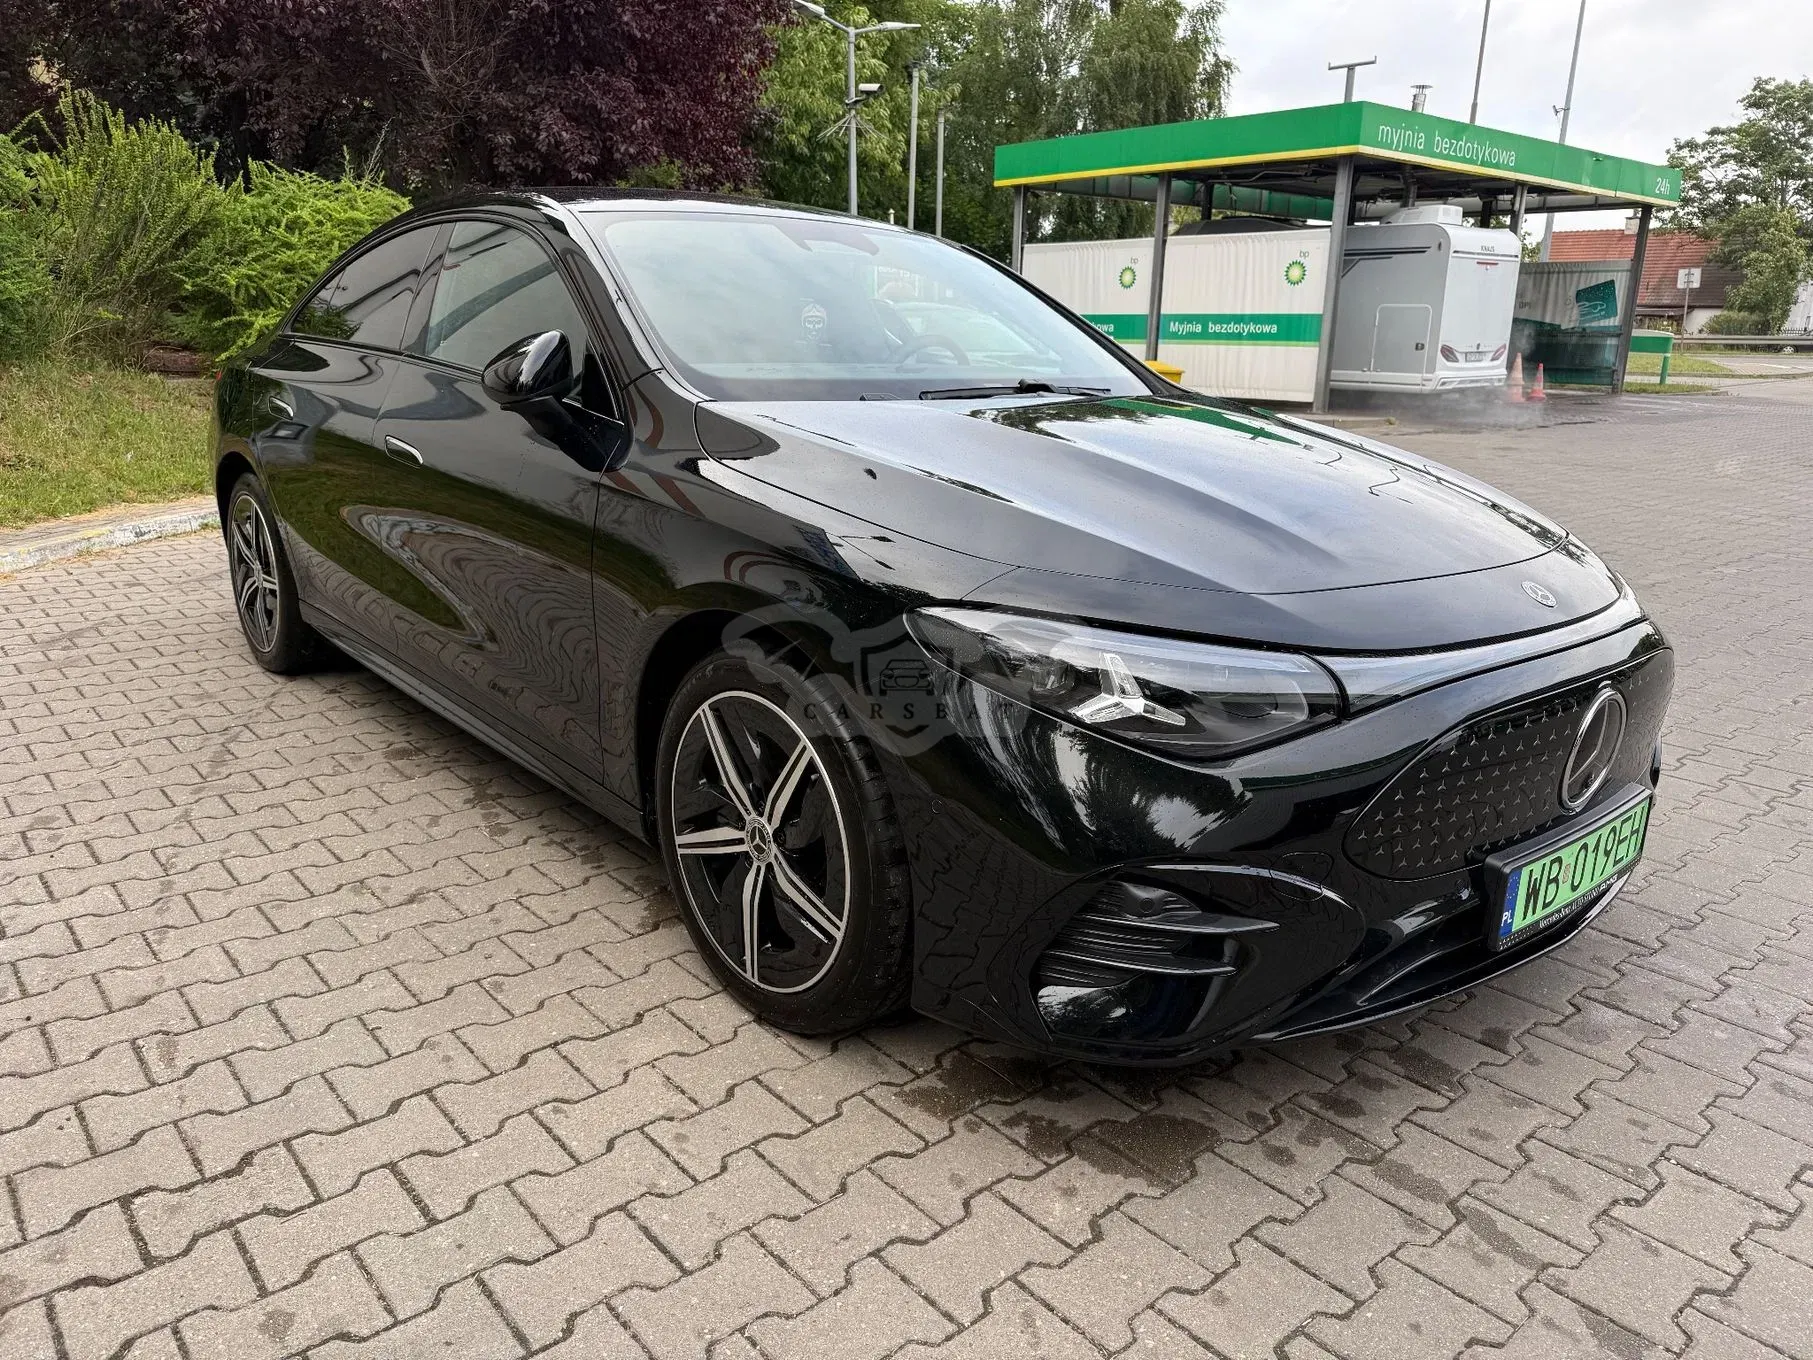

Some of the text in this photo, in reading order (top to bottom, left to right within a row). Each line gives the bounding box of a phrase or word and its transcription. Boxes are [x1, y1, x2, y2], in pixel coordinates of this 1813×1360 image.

[1378, 122, 1516, 166] myjnia bezdotykowa
[1655, 177, 1670, 195] 24h
[1130, 256, 1139, 265] bp
[1299, 250, 1310, 260] bp
[1169, 321, 1278, 336] Myjnia bezdotykowa
[1501, 909, 1513, 927] PL
[1522, 855, 1564, 922] WB
[1570, 805, 1647, 893] 019EH
